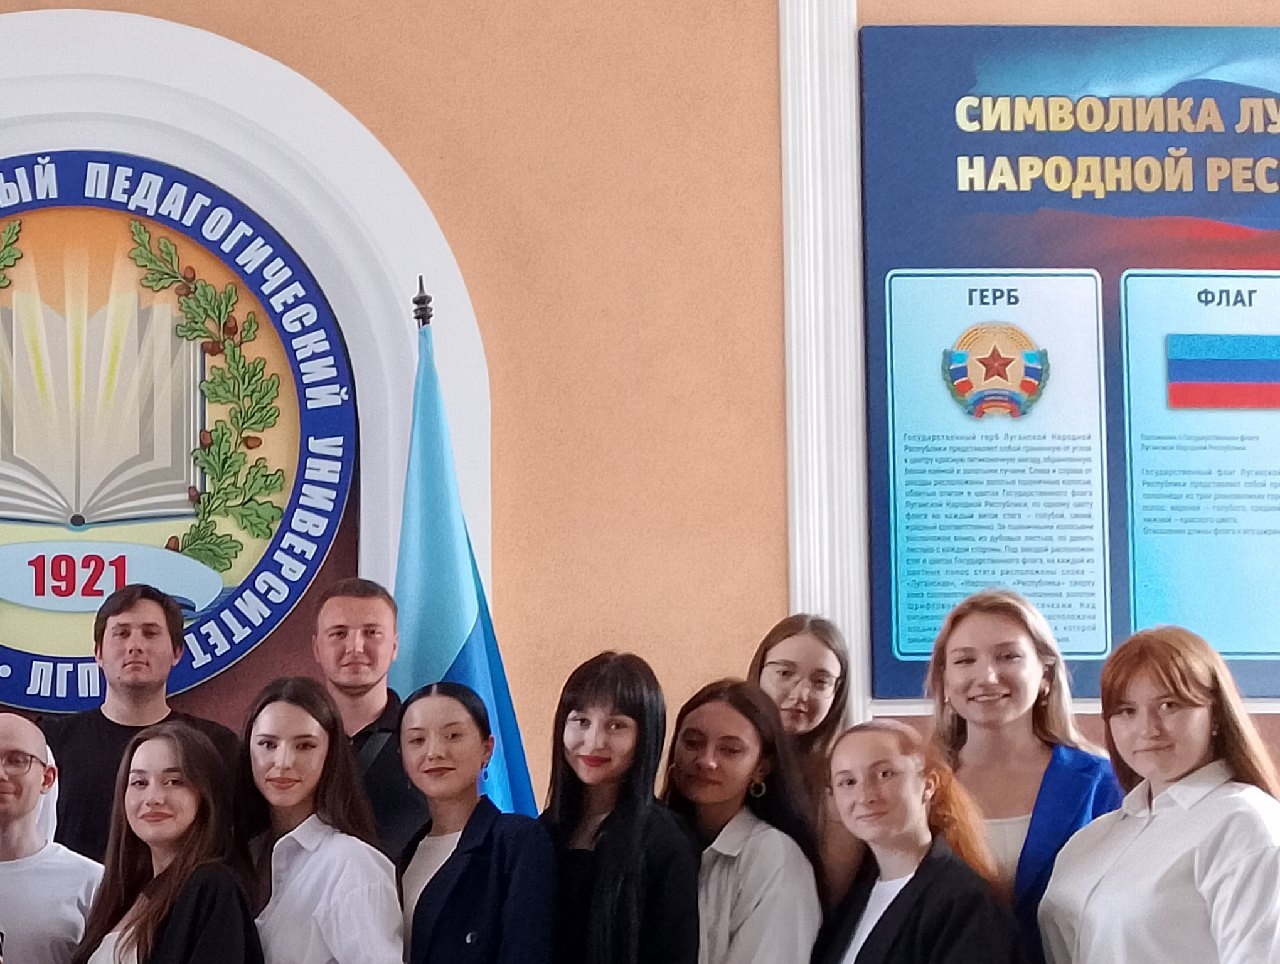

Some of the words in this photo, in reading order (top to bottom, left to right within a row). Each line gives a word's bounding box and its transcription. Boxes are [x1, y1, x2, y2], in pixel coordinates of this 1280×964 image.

[955, 95, 1225, 133] СИМВОЛИКА
[956, 147, 1194, 198] НАРОДНОЙ
[1206, 156, 1280, 194] РЕС
[84, 161, 350, 410] ПЕДАГОГИЧЕСКИЙ
[967, 288, 1020, 306] ГЕРБ
[1197, 289, 1257, 308] ФЛАГ
[186, 435, 344, 670] УНИВЕРСИТЕТ
[27, 554, 127, 597] 1921
